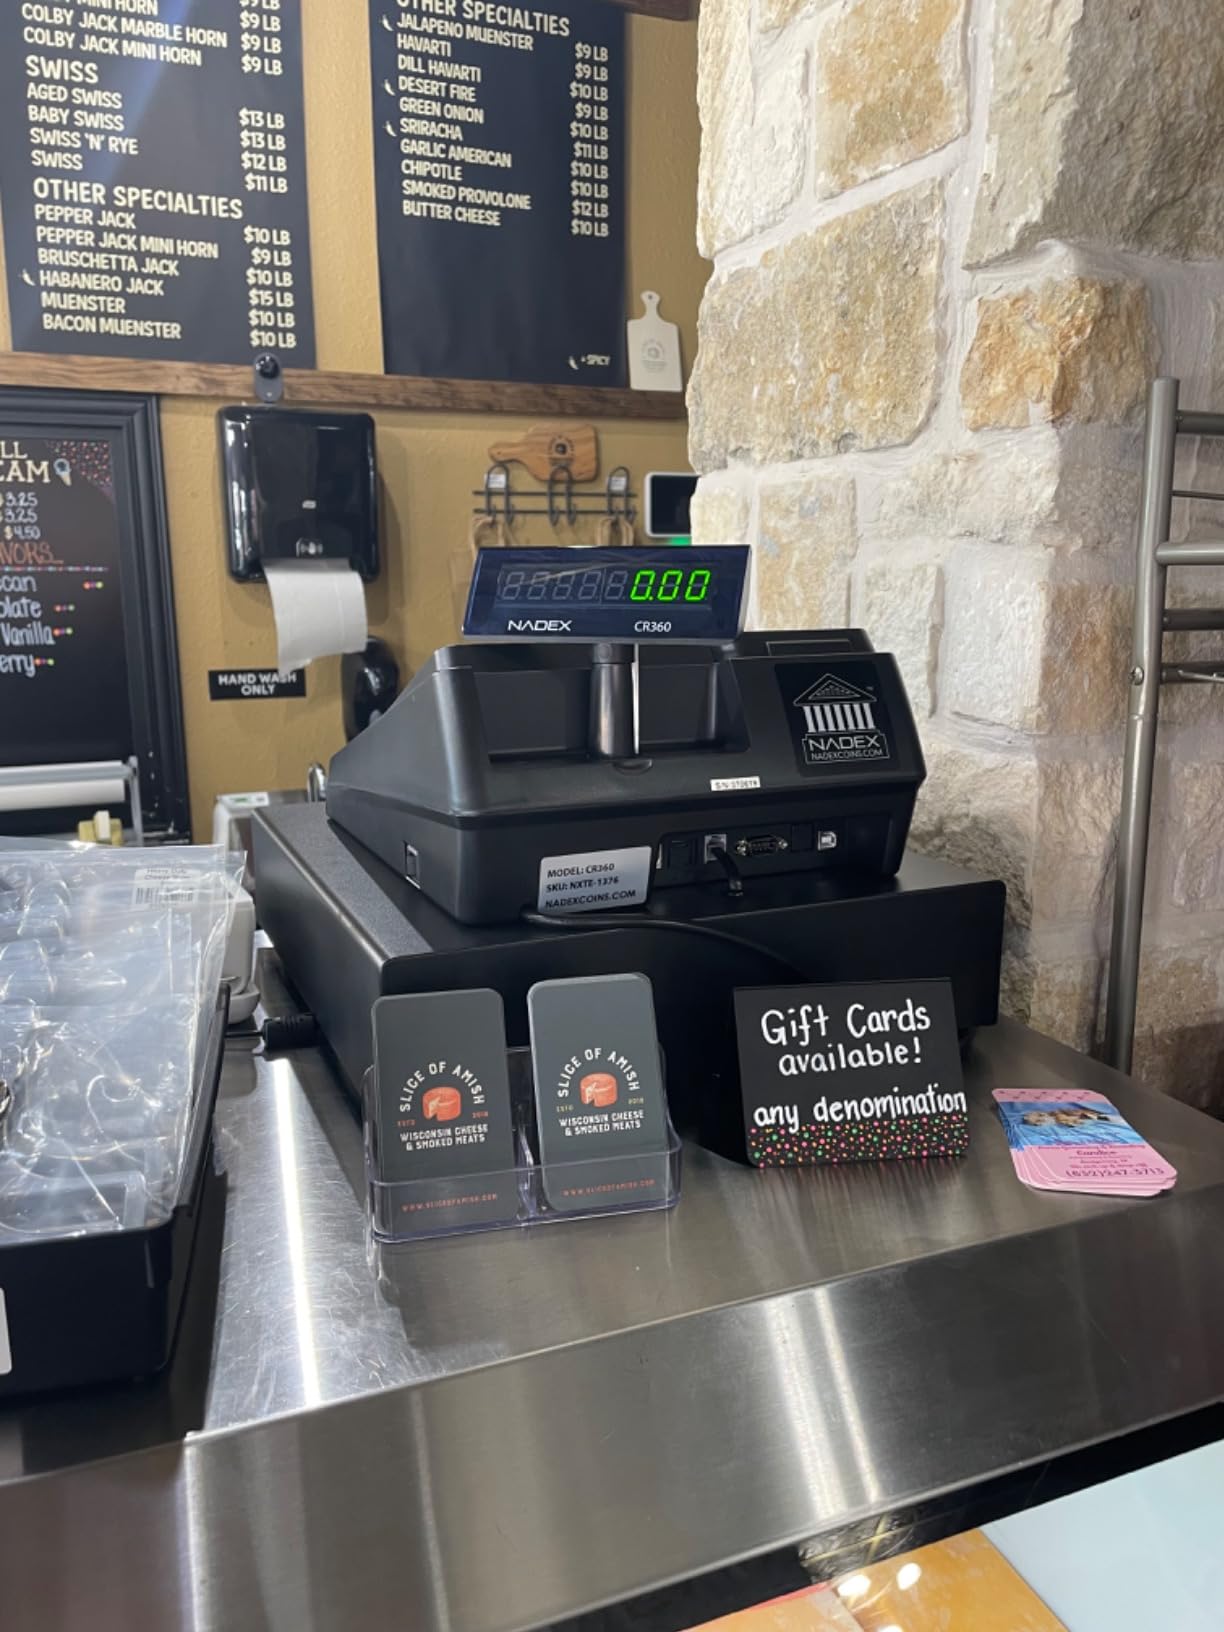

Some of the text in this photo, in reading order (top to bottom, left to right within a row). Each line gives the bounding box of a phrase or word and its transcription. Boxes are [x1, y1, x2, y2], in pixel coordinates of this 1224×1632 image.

[115, 0, 158, 16] HORN
[462, 0, 570, 36] SPECIALTIES
[22, 4, 227, 48] COLBY JACK MARBLE HORN
[240, 11, 281, 31] $9 LB
[398, 12, 533, 50] JALAPENO MUENSTER
[24, 26, 201, 66] COLBY JACK MINI HORN
[241, 33, 282, 53] $9 LB
[398, 34, 451, 57] HAVARTI
[575, 43, 608, 61] $9 LB
[26, 55, 98, 84] SWISS
[242, 54, 282, 75] $9 LB
[398, 54, 481, 82] DILL HAVARTI
[575, 63, 608, 81] $9 LB
[27, 83, 122, 109] AGED SWISS
[398, 76, 476, 102] DESERT FIRE
[570, 82, 608, 101] $10 LB
[28, 105, 124, 131] BABY SWISS
[239, 107, 285, 129] $13 LB
[399, 98, 484, 124] GREEN ONION
[576, 103, 608, 120] $9 LB
[240, 129, 286, 150] $13 LB
[400, 119, 462, 141] SRIRACHA
[570, 122, 608, 139] $10 LB
[30, 128, 80, 148] SWISS
[108, 136, 138, 154] RYE
[574, 142, 608, 159] $11 LB
[31, 150, 83, 171] SWISS
[241, 151, 287, 172] $12 LB
[401, 139, 511, 168] GARLIC AMERICAN
[401, 160, 462, 181] CHIPOTLE
[571, 162, 608, 179] $10 LB
[245, 173, 287, 193] $11 LB
[571, 181, 608, 198] $10 LB
[33, 177, 242, 219] OTHER SPECIALTIES
[402, 180, 532, 210] SMOKED PROVOLONE
[35, 204, 136, 229] PEPPER JACK
[402, 201, 501, 226] BUTTER CHEESE
[572, 201, 608, 218] $12 LB
[244, 226, 290, 245] $10 LB
[571, 220, 608, 237] $10 LB
[37, 226, 218, 258] PEPPER JACK MINI HORN
[38, 248, 179, 276] BRUSCHETTA JACK
[251, 247, 291, 266] $9 LB
[40, 271, 164, 295] HABANERO JACK
[246, 268, 293, 287] $10 LB
[41, 291, 125, 314] MUENSTER
[249, 289, 294, 307] $15 LB
[43, 314, 181, 339] BACON MUENSTER
[249, 310, 295, 327] $10 LB
[250, 330, 296, 348] $10 LB
[629, 568, 712, 602] 0.00
[508, 619, 672, 633] NADEX CR360
[218, 673, 256, 685] HAND
[240, 684, 276, 696] ONLY
[808, 735, 880, 751] NADEX
[547, 866, 584, 878] MODEL:
[761, 999, 930, 1046] Gift Cards
[778, 1037, 921, 1076] available!
[557, 1047, 640, 1098] SLICE OF AMISH
[400, 1061, 485, 1112] SLICE OF AMISH
[754, 1084, 966, 1133] any denomination
[559, 1113, 608, 1127] WISCONSIN
[400, 1128, 452, 1142] WISCONSIN
